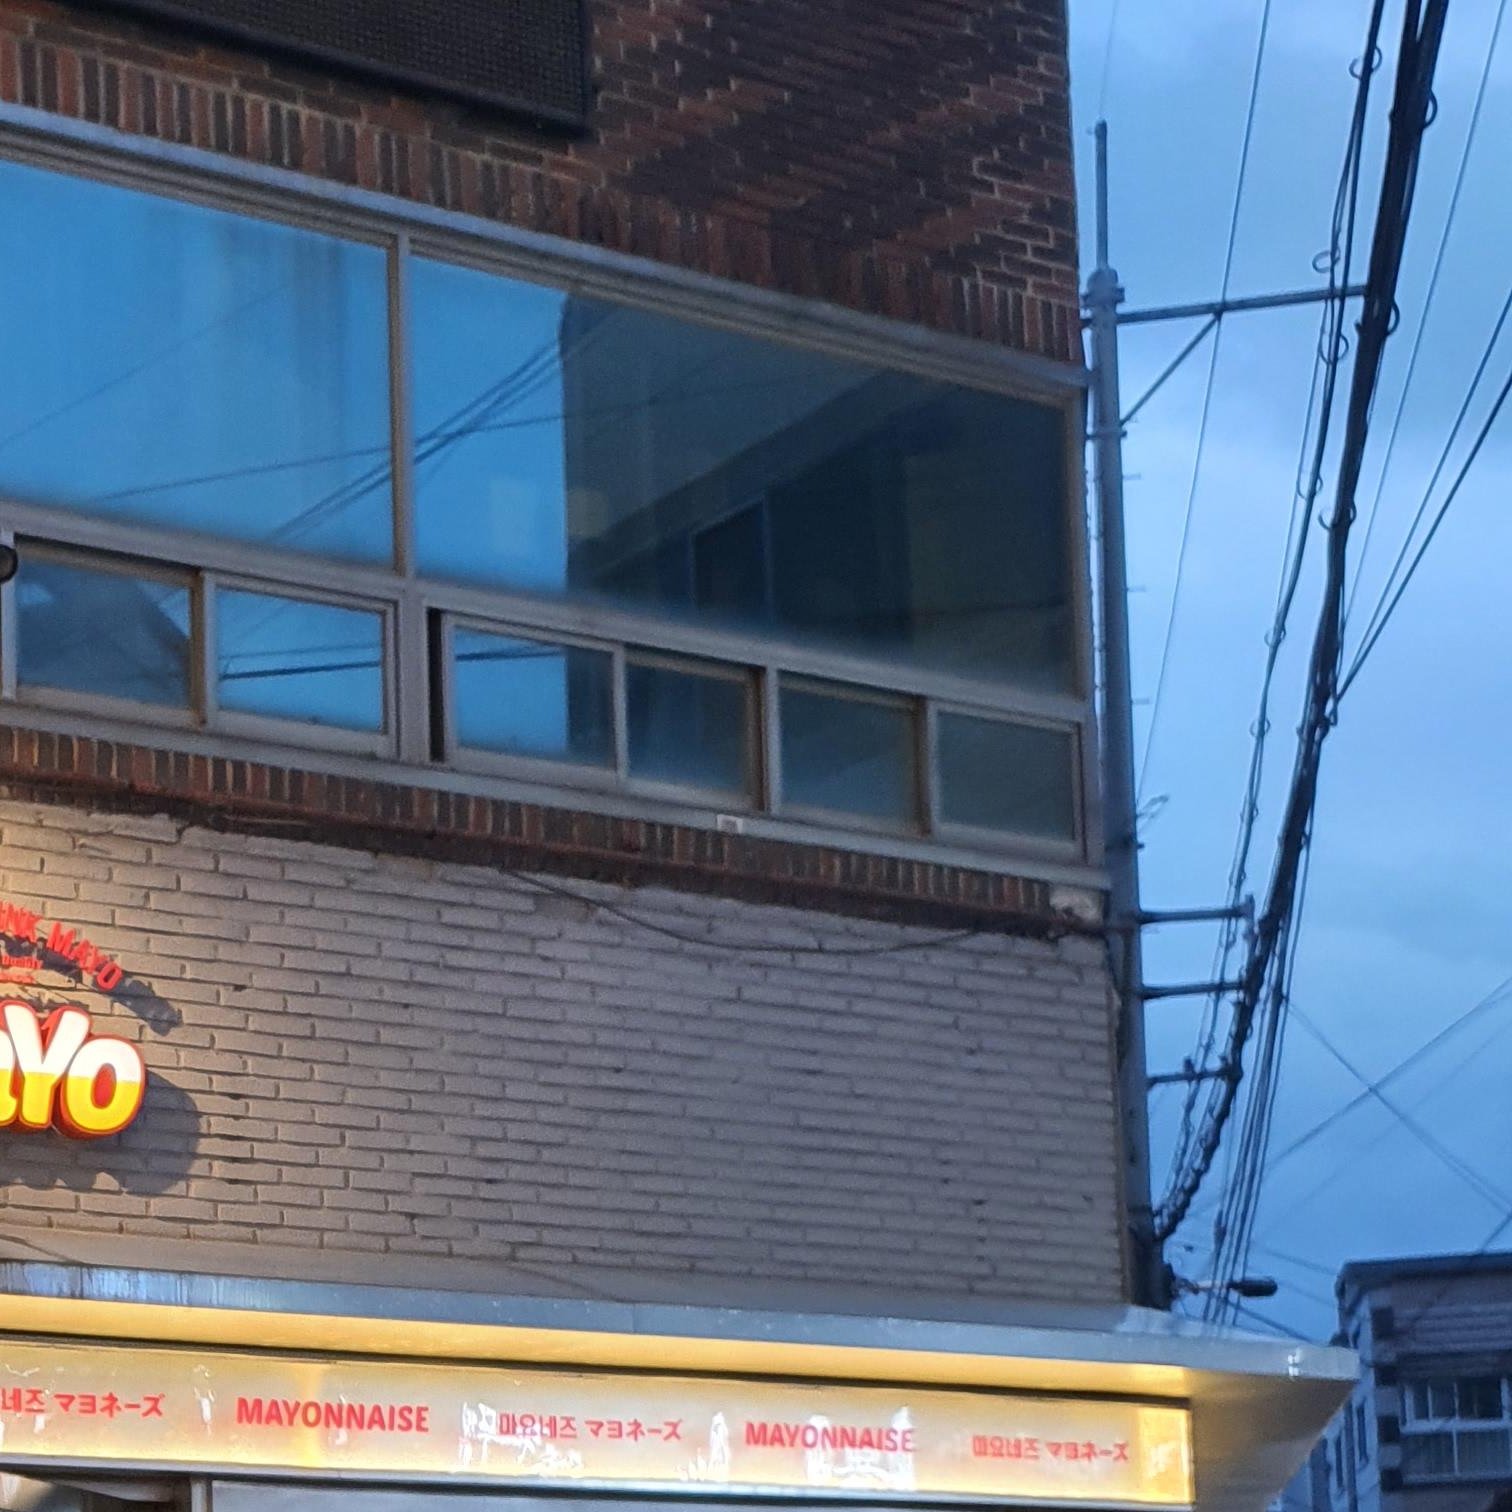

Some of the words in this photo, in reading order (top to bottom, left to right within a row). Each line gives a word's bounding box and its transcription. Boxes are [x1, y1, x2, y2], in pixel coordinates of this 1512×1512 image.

[46, 921, 122, 990] MAYO
[53, 1392, 165, 1418] マヨネーズ
[236, 1397, 429, 1432] MAYONNAISE
[499, 1413, 577, 1440] 마요네즈
[585, 1419, 682, 1442] マヨネーズ
[745, 1422, 915, 1453] MAYONNAISE
